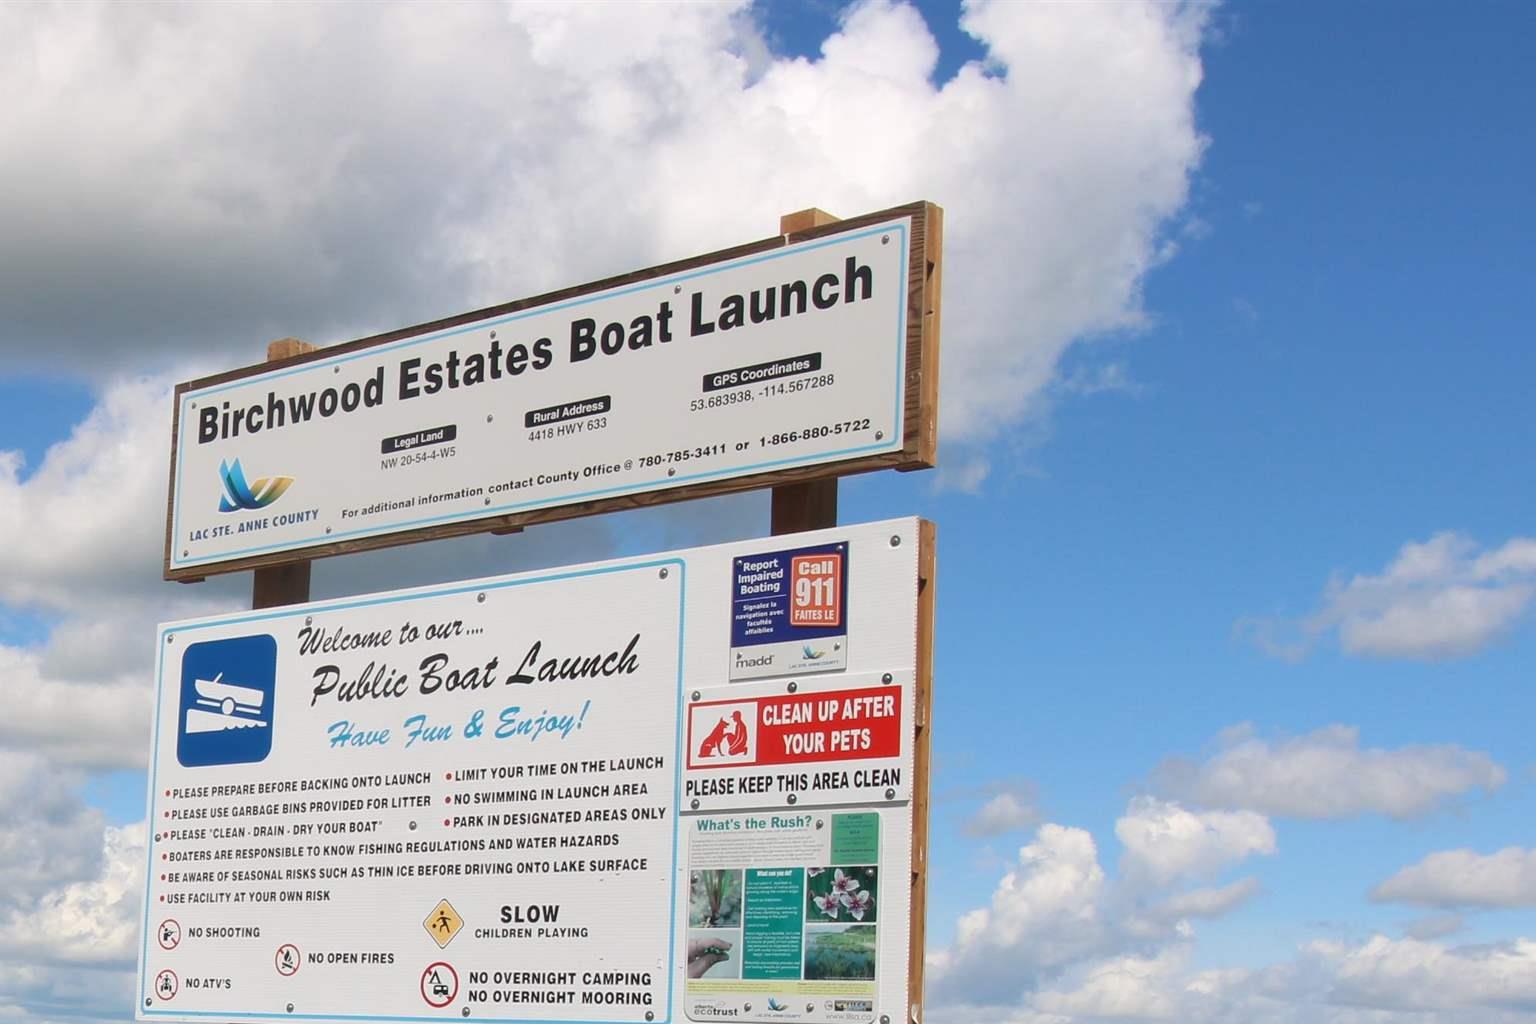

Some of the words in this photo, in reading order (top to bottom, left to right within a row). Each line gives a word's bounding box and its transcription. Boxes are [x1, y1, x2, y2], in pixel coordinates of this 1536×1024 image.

[198, 366, 385, 444] Birchwood
[399, 337, 553, 400] Estates
[570, 301, 673, 362] Boat
[690, 256, 873, 337] Launch
[713, 371, 738, 388] GPS
[741, 358, 810, 383] Coordinates
[690, 389, 755, 411] 53.683938,
[759, 374, 834, 399] -114.567288
[533, 407, 559, 424] Rural
[562, 399, 604, 418] Address
[395, 436, 418, 449] Legal
[421, 429, 443, 442] Land
[528, 426, 554, 442] 4418
[557, 421, 584, 437] HWY
[587, 417, 607, 432] 633
[342, 508, 358, 519] For
[361, 497, 414, 515] additional
[418, 486, 483, 506] information
[489, 476, 533, 494] contact
[537, 469, 579, 486] County
[583, 462, 621, 477] Office
[624, 459, 633, 471] @
[639, 444, 726, 468] 780-785-3411
[736, 441, 749, 452] or
[760, 418, 870, 447] 1-866-880-5722
[381, 457, 398, 470] NW
[401, 446, 456, 466] 20-54-4-W5
[190, 528, 208, 541] LAC
[213, 524, 233, 538] STE.
[238, 518, 268, 533] ANNE
[273, 509, 319, 528] COUNTY
[738, 569, 784, 584] Impaired
[744, 559, 778, 572] Report
[799, 561, 833, 574] Call
[741, 582, 780, 594] Boating
[796, 578, 834, 606] 911
[795, 610, 822, 620] FAITES
[825, 610, 834, 619] LE
[298, 626, 391, 655] Welcome
[399, 622, 420, 644] to
[311, 661, 408, 706] Public
[420, 653, 498, 694] Boat
[506, 634, 640, 685] Launch
[763, 702, 813, 726] CLEAN
[818, 701, 838, 722] UP
[843, 696, 894, 719] AFTER
[328, 720, 390, 748] Have
[403, 715, 454, 748] Fun
[464, 710, 485, 738] &
[495, 700, 591, 741] Enjoy!
[784, 732, 824, 755] YOUR
[831, 729, 870, 751] PETS
[455, 769, 487, 781] LIMIT
[491, 767, 524, 779] YOUR
[528, 764, 557, 777] TIME
[561, 763, 578, 775] ON
[582, 761, 606, 773] THE
[610, 757, 664, 772] LAUNCH
[173, 787, 209, 798] PLEASE
[212, 784, 255, 796] PREPARE
[258, 781, 298, 793] BEFORE
[301, 778, 349, 791] BACKING
[352, 776, 381, 788] ONTO
[385, 773, 431, 786] LAUNCH
[686, 777, 735, 796] PLEASE
[739, 775, 773, 794] KEEP
[777, 773, 807, 792] THIS
[813, 771, 849, 790] AREA
[854, 768, 900, 788] CLEAN
[454, 793, 470, 805] NO
[474, 790, 537, 804] SWIMMING
[541, 789, 554, 800] IN
[558, 786, 609, 799] LAUNCH
[613, 784, 648, 796] AREA
[172, 808, 207, 819] PLEASE
[210, 807, 229, 817] USE
[232, 804, 279, 816] GARBAGE
[282, 803, 307, 813] BINS
[310, 800, 364, 812] PROVIDED
[367, 798, 388, 809] FOR
[392, 796, 431, 808] LITTER
[453, 816, 484, 827] PARK
[488, 816, 500, 826] IN
[503, 812, 581, 825] DESIGNATED
[585, 810, 627, 822] AREAS
[632, 808, 666, 820] ONLY
[171, 829, 206, 840] PLEASE
[210, 828, 245, 838] "CLEAN
[254, 826, 284, 836] DRAIN
[294, 824, 314, 835] DRY
[317, 823, 346, 834] YOUR
[349, 821, 383, 832] BOAT"
[697, 818, 741, 831] What's
[746, 818, 766, 829] the
[771, 816, 812, 828] Rush?
[169, 851, 212, 861] BOATERS
[214, 850, 233, 859] ARE
[236, 847, 304, 859] RESPONSIBLE
[308, 846, 320, 856] TO
[324, 845, 355, 856] KNOW
[359, 843, 403, 855] FISHING
[406, 840, 485, 853] REGULATIONS
[489, 839, 513, 850] AND
[517, 837, 557, 849] WATER
[561, 834, 619, 847] HAZARDS
[168, 873, 180, 882] BE
[183, 872, 214, 882] AWARE
[217, 872, 229, 881] OF
[232, 870, 283, 881] SEASONAL
[286, 869, 316, 879] RISKS
[320, 868, 347, 878] SUCH
[350, 868, 364, 878] AS
[368, 867, 393, 877] THIN
[397, 866, 414, 876] ICE
[418, 865, 462, 876] BEFORE
[465, 863, 513, 875] DRIVING
[517, 862, 550, 873] ONTO
[554, 861, 585, 872] LAKE
[590, 859, 647, 872] SURFACE
[167, 894, 185, 903] USE
[188, 893, 231, 903] FACILITY
[235, 893, 246, 902] AT
[249, 892, 276, 902] YOUR
[279, 892, 302, 901] OWN
[306, 891, 330, 901] RISK
[501, 905, 559, 923] SLOW
[189, 928, 203, 938] NO
[206, 928, 260, 937] SHOOTING
[475, 929, 532, 938] CHILDREN
[538, 928, 588, 938] PLAYING
[308, 953, 324, 963] NO
[328, 953, 358, 964] OPEN
[361, 953, 394, 964] FIRES
[186, 979, 200, 988] NO
[203, 979, 231, 989] ATV'S
[469, 972, 488, 984] NO
[494, 973, 576, 985] OVERNIGHT
[583, 973, 651, 985] CAMPING
[469, 991, 487, 1002] NO
[493, 991, 575, 1004] OVERNIGHT
[582, 992, 652, 1005] MOORING
